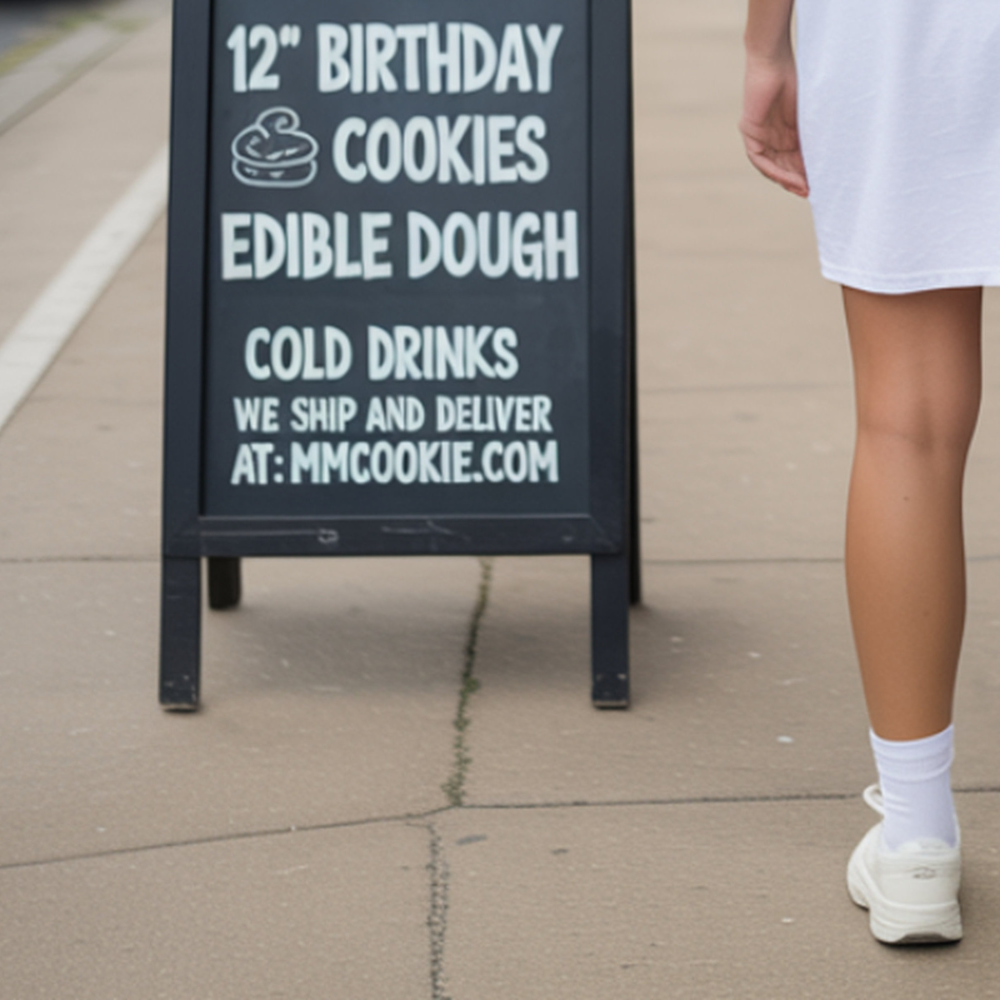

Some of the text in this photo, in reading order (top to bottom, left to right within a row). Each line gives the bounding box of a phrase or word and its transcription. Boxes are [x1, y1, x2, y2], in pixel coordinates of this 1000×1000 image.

[316, 21, 563, 94] BIRTHDAY
[332, 114, 549, 186] COOKIES
[221, 209, 579, 281] EDIBLE DOUGH
[245, 325, 519, 381] COLD DRINKS
[233, 394, 553, 433] WE SHIP AND DELIVER
[231, 439, 559, 485] AT: MMCOOKIE.COM
